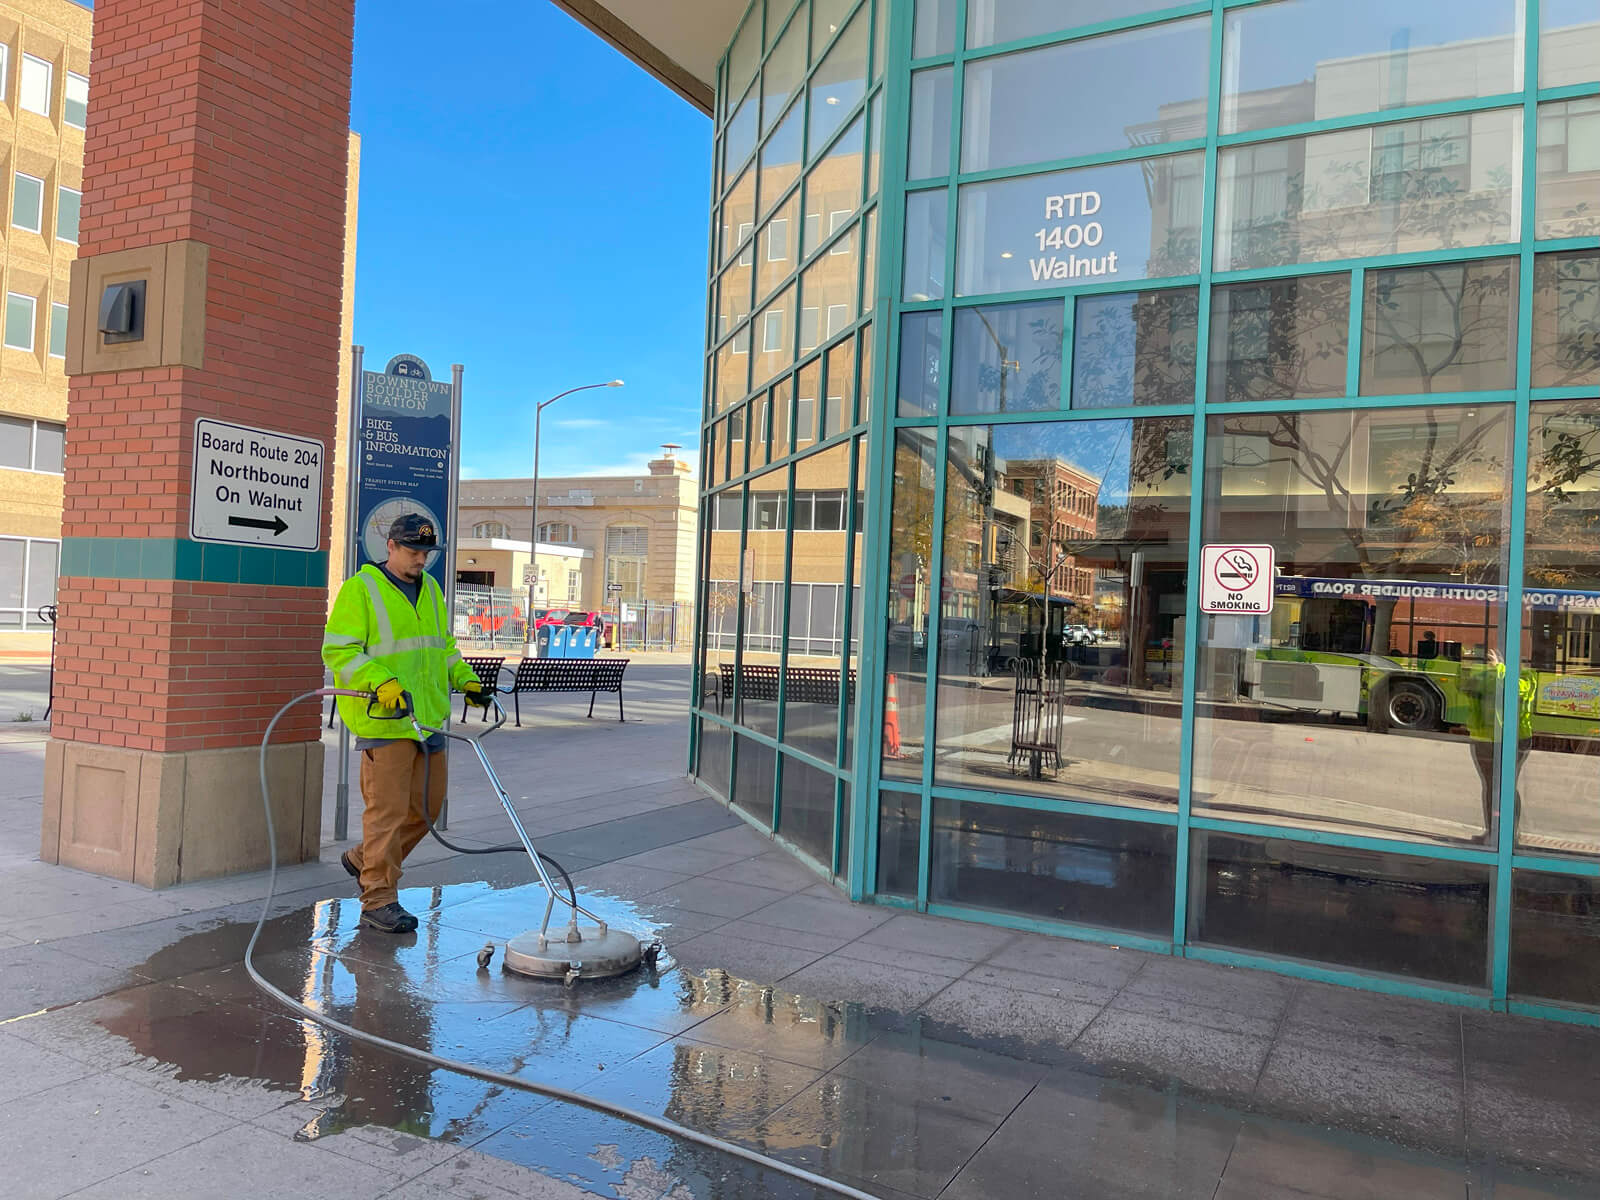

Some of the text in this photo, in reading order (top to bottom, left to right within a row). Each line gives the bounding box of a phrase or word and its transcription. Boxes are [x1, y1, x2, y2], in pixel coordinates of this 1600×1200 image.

[1045, 191, 1101, 219] RTD
[1034, 222, 1103, 251] 1400
[1029, 251, 1118, 281] Walnut
[367, 373, 449, 395] DOWNTOWN
[367, 383, 429, 402] BOULDER
[366, 393, 426, 410] STATION
[366, 418, 393, 431] BIKE
[365, 429, 399, 443] & BUS
[201, 432, 319, 467] Board Route 204
[365, 440, 447, 460] INFORMATION
[210, 459, 309, 489] Northbound
[216, 485, 302, 512] On Walnut
[524, 574, 537, 583] 20
[1210, 601, 1261, 610] SMOKING
[1228, 593, 1243, 601] NO
